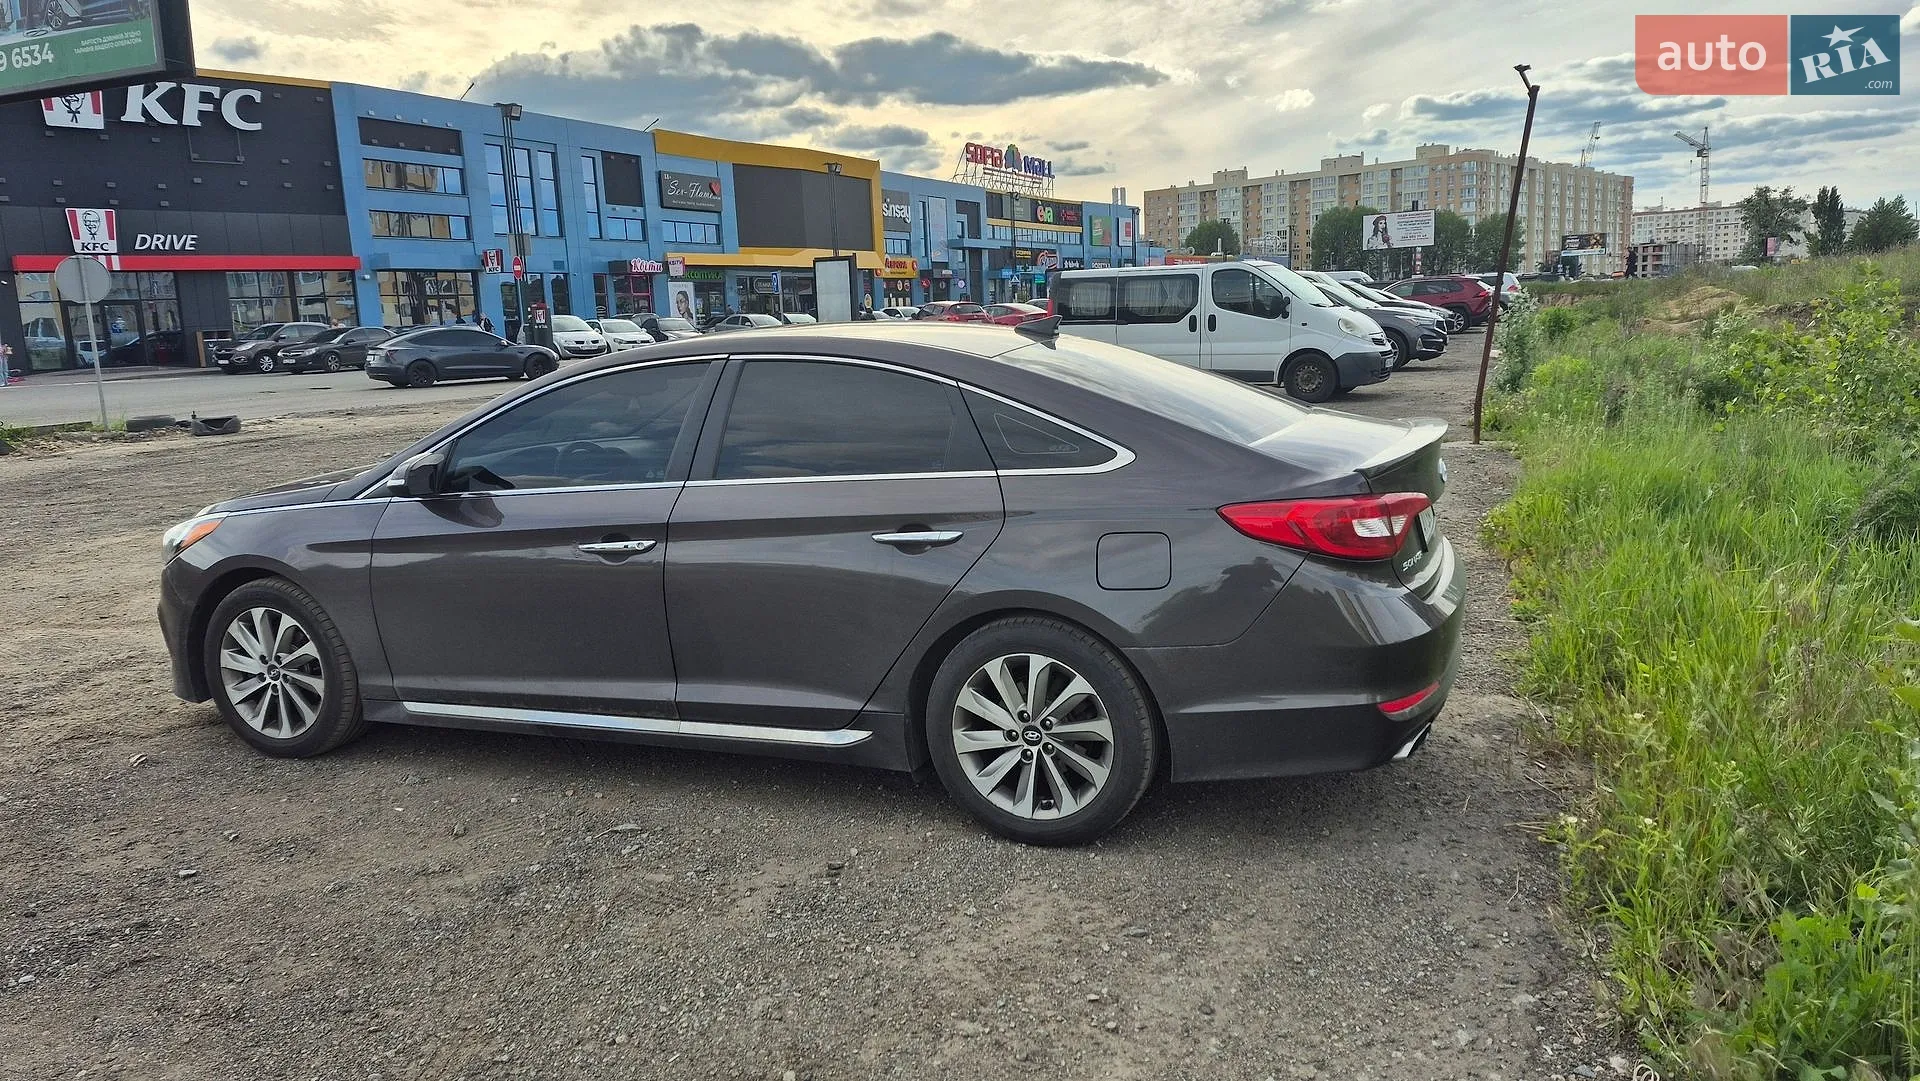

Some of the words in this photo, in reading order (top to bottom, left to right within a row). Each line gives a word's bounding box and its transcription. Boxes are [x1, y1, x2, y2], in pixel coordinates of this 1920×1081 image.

[12, 42, 54, 69] 6534
[121, 82, 262, 131] KFC
[882, 198, 911, 223] sinsay
[80, 242, 110, 252] KFC
[134, 233, 199, 251] DRIVE
